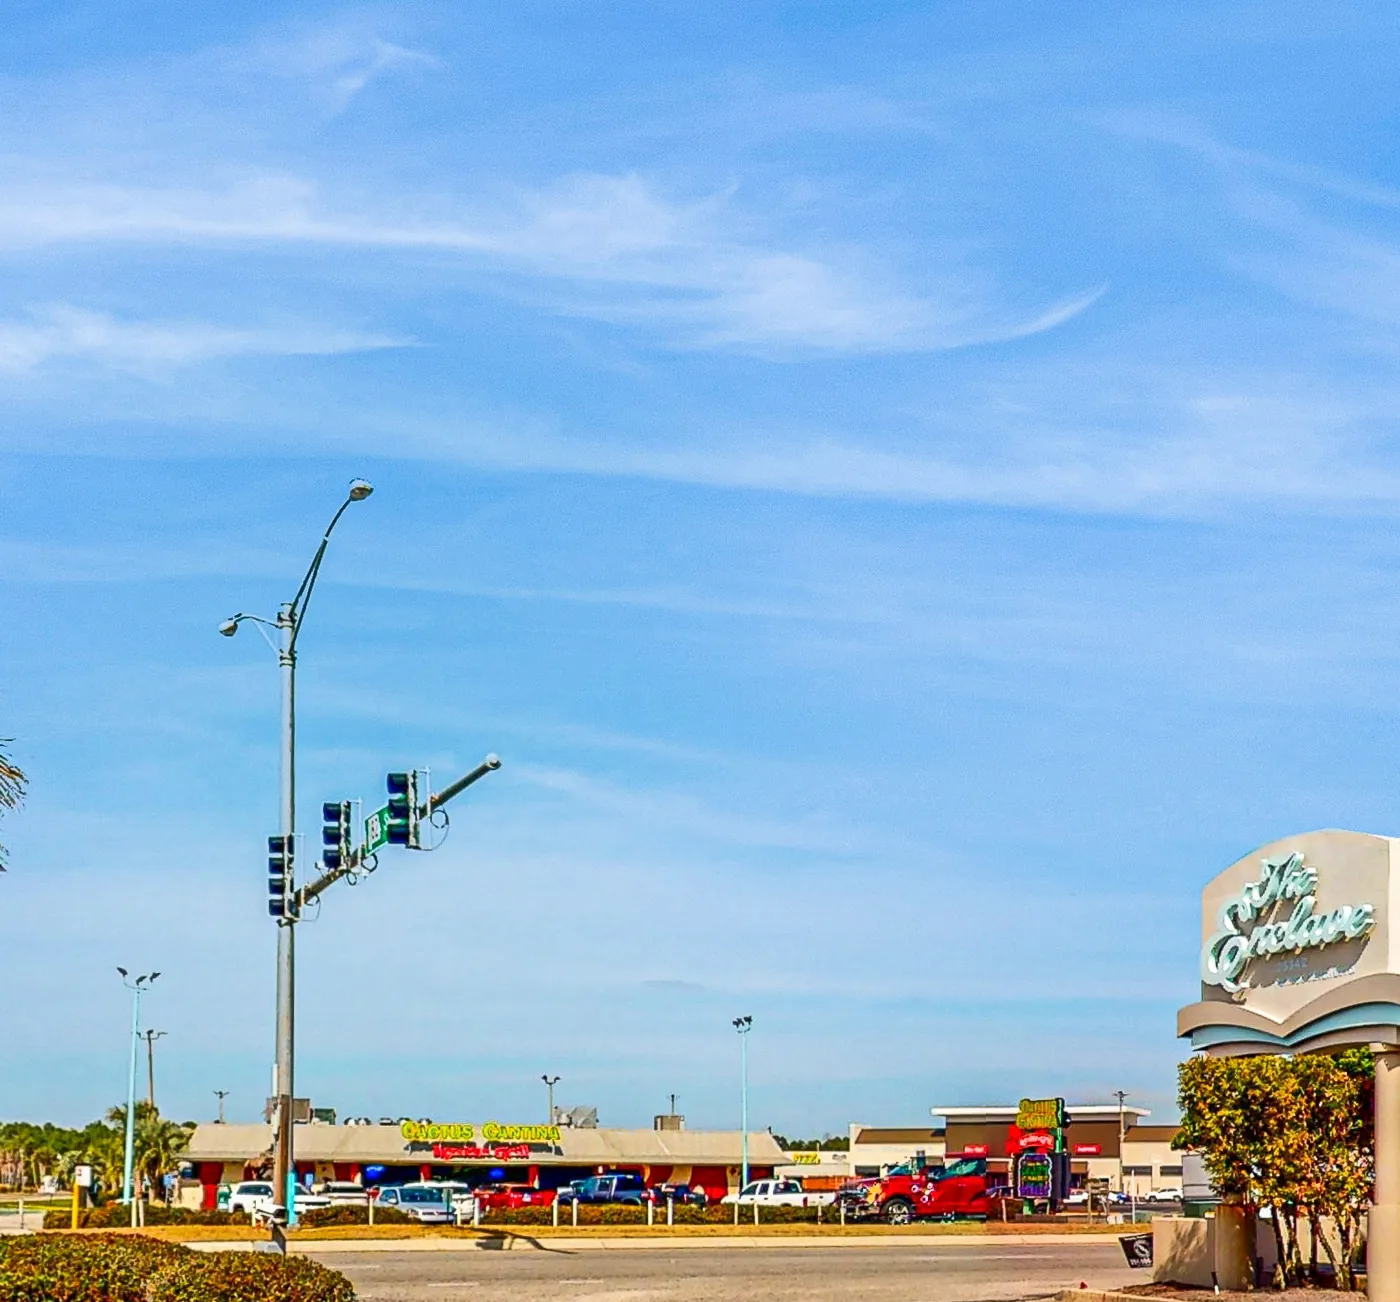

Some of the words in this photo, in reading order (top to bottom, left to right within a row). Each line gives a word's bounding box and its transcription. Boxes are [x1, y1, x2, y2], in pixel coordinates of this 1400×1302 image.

[1250, 851, 1319, 908] The
[1202, 884, 1376, 993] Enclave
[401, 1121, 474, 1141] CACTUS
[481, 1121, 562, 1142] CANTINA
